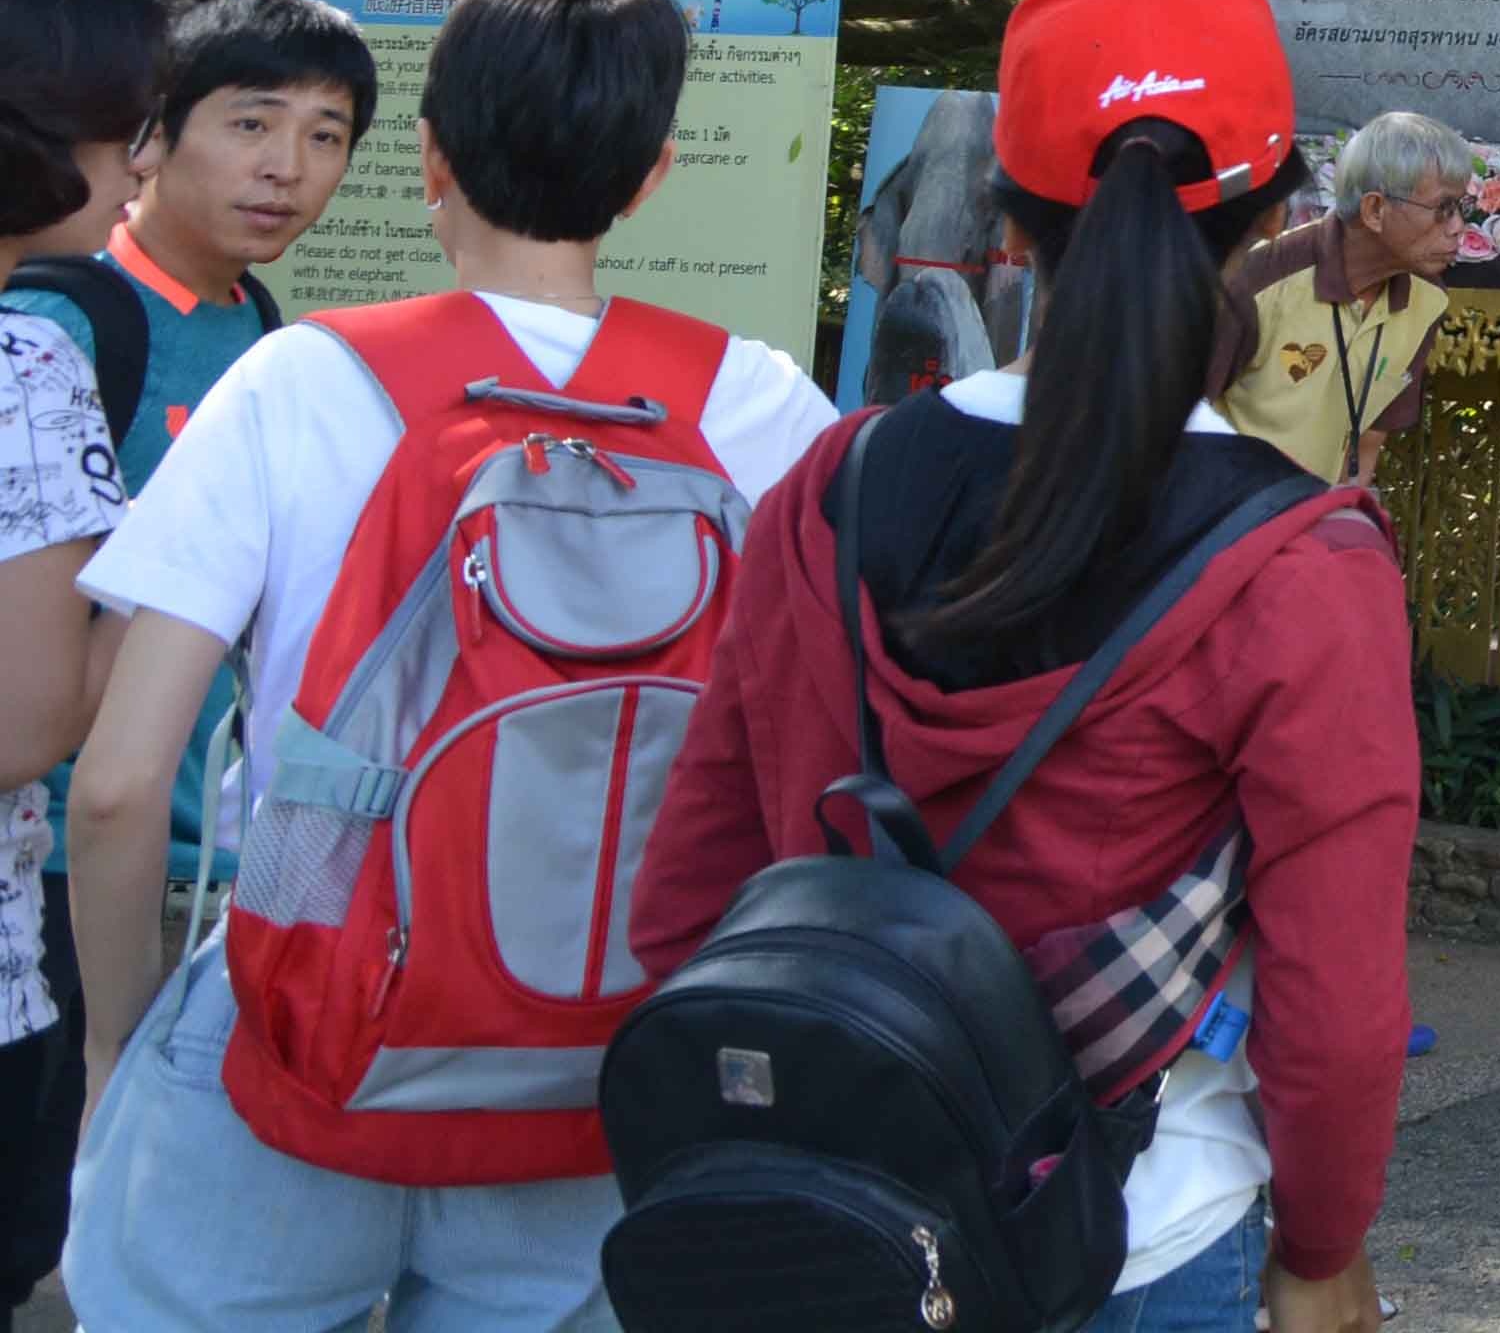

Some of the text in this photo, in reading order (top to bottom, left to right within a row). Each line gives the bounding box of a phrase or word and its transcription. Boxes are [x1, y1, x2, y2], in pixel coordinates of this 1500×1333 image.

[375, 161, 424, 177] banana
[674, 152, 731, 168] ugarcane
[734, 154, 750, 166] or
[296, 243, 336, 259] Please
[339, 246, 357, 260] do
[360, 248, 381, 262] not
[385, 250, 405, 264] get
[408, 248, 442, 263] close
[594, 255, 634, 270] ahout
[648, 256, 676, 271] staff
[680, 259, 689, 273] is
[694, 259, 714, 274] not
[718, 260, 768, 277] present
[294, 265, 409, 285] with the elephant.
